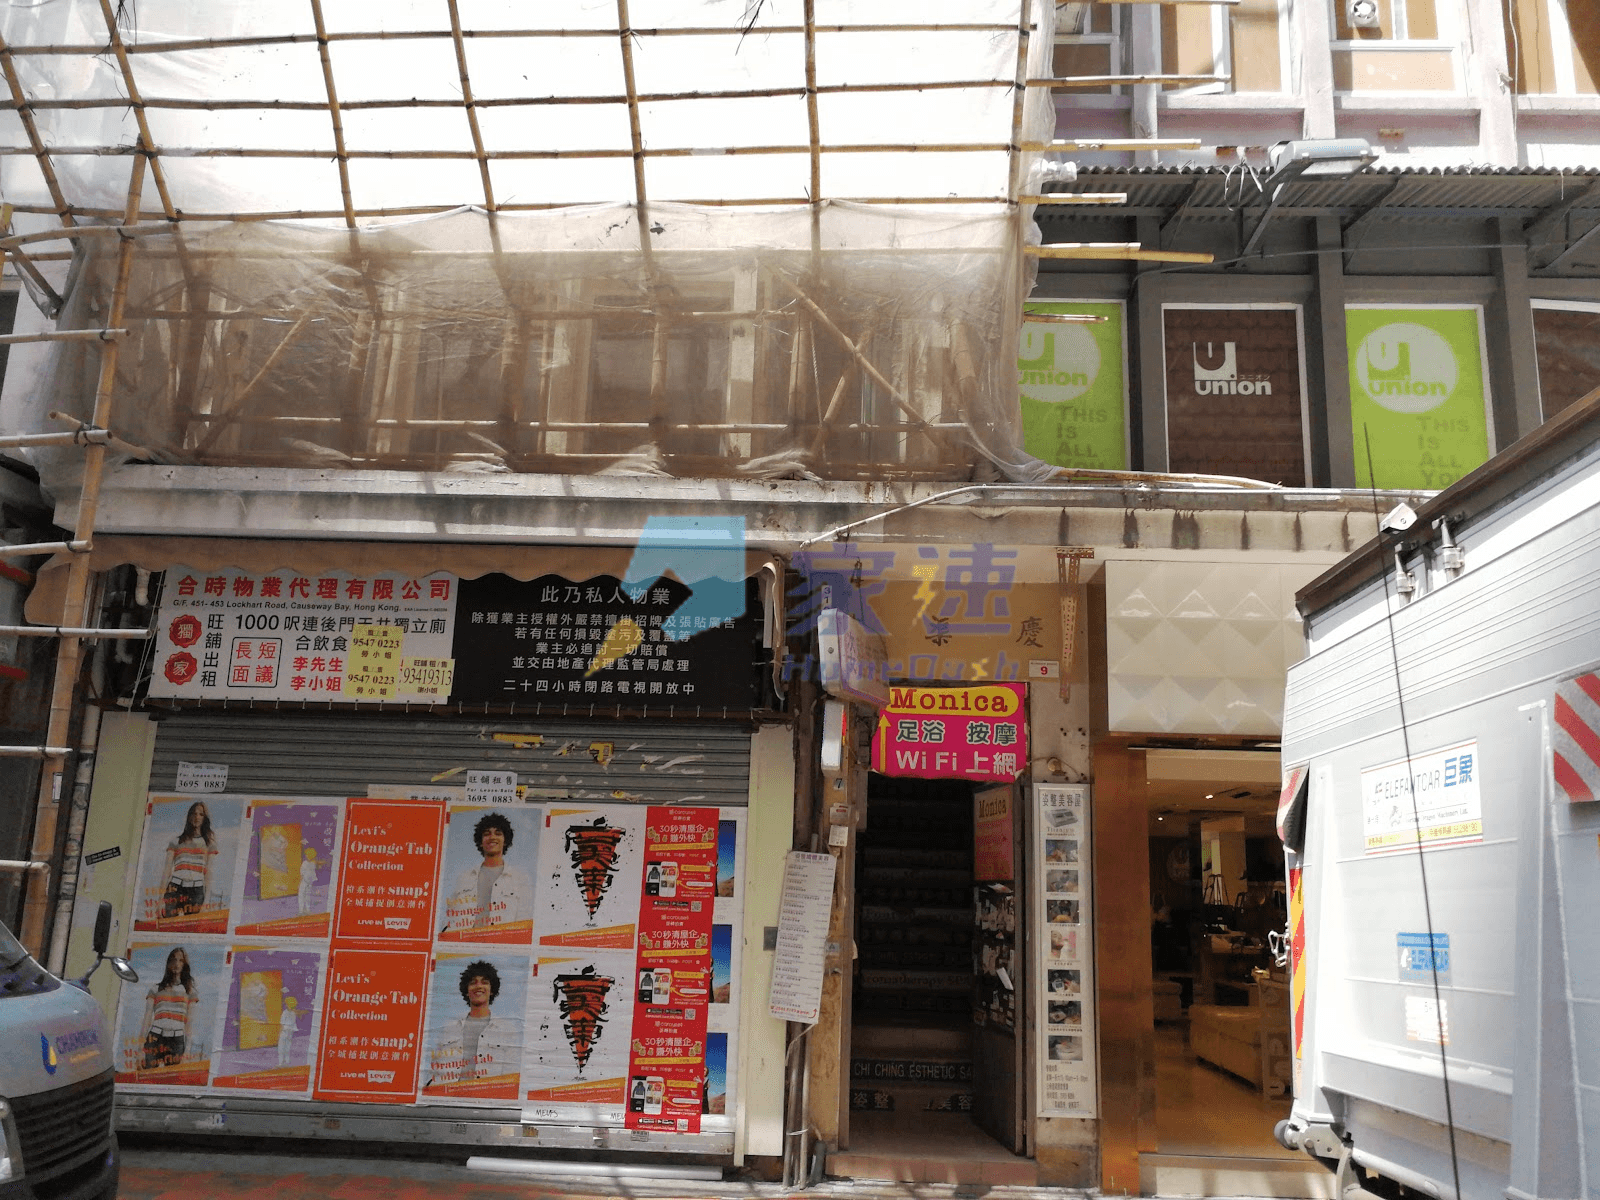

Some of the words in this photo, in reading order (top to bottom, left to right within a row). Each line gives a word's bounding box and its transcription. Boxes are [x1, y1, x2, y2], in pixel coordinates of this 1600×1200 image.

[178, 575, 451, 600] 合時物業代理有限公司
[541, 585, 670, 605] 此乃私人物業
[290, 602, 332, 611] Causeway
[354, 604, 377, 612] Hong
[296, 635, 347, 652] 合飲食
[353, 638, 375, 647] 9547
[377, 639, 400, 649] 0223
[536, 642, 668, 657] 業主必追討一切賠償
[292, 656, 343, 673] 李先生
[511, 656, 690, 672] 並交由地產代理監管局處理
[1040, 666, 1048, 676] 9
[290, 675, 342, 692] 李小姐
[347, 674, 370, 683] 9547
[372, 675, 395, 685] 0223
[403, 668, 452, 686] 93419313
[891, 688, 1009, 713] Monica
[895, 719, 946, 744] 足浴
[966, 721, 1018, 746] 按摩
[965, 751, 1017, 777] 上網
[1444, 754, 1473, 788] 巨象
[178, 780, 199, 788] 3695
[204, 780, 225, 789] 0883
[836, 778, 842, 789] 7
[467, 794, 487, 803] 3695
[492, 795, 513, 803] 0883
[979, 798, 1007, 818] Monica
[351, 841, 404, 856] Orange
[406, 842, 433, 856] Tab
[349, 860, 404, 871] Collection
[387, 882, 430, 899] snap!
[446, 905, 485, 917] Orange
[446, 915, 502, 928] Collection
[333, 989, 388, 1006] Orange
[390, 990, 418, 1004] Tab
[331, 1009, 388, 1021] Collection
[371, 1032, 414, 1050] snap!
[430, 1058, 470, 1071] Orange
[854, 1062, 870, 1076] CHI
[874, 1063, 905, 1077] CHING
[908, 1064, 955, 1079] ESTHETIC
[431, 1069, 487, 1082] Collection
